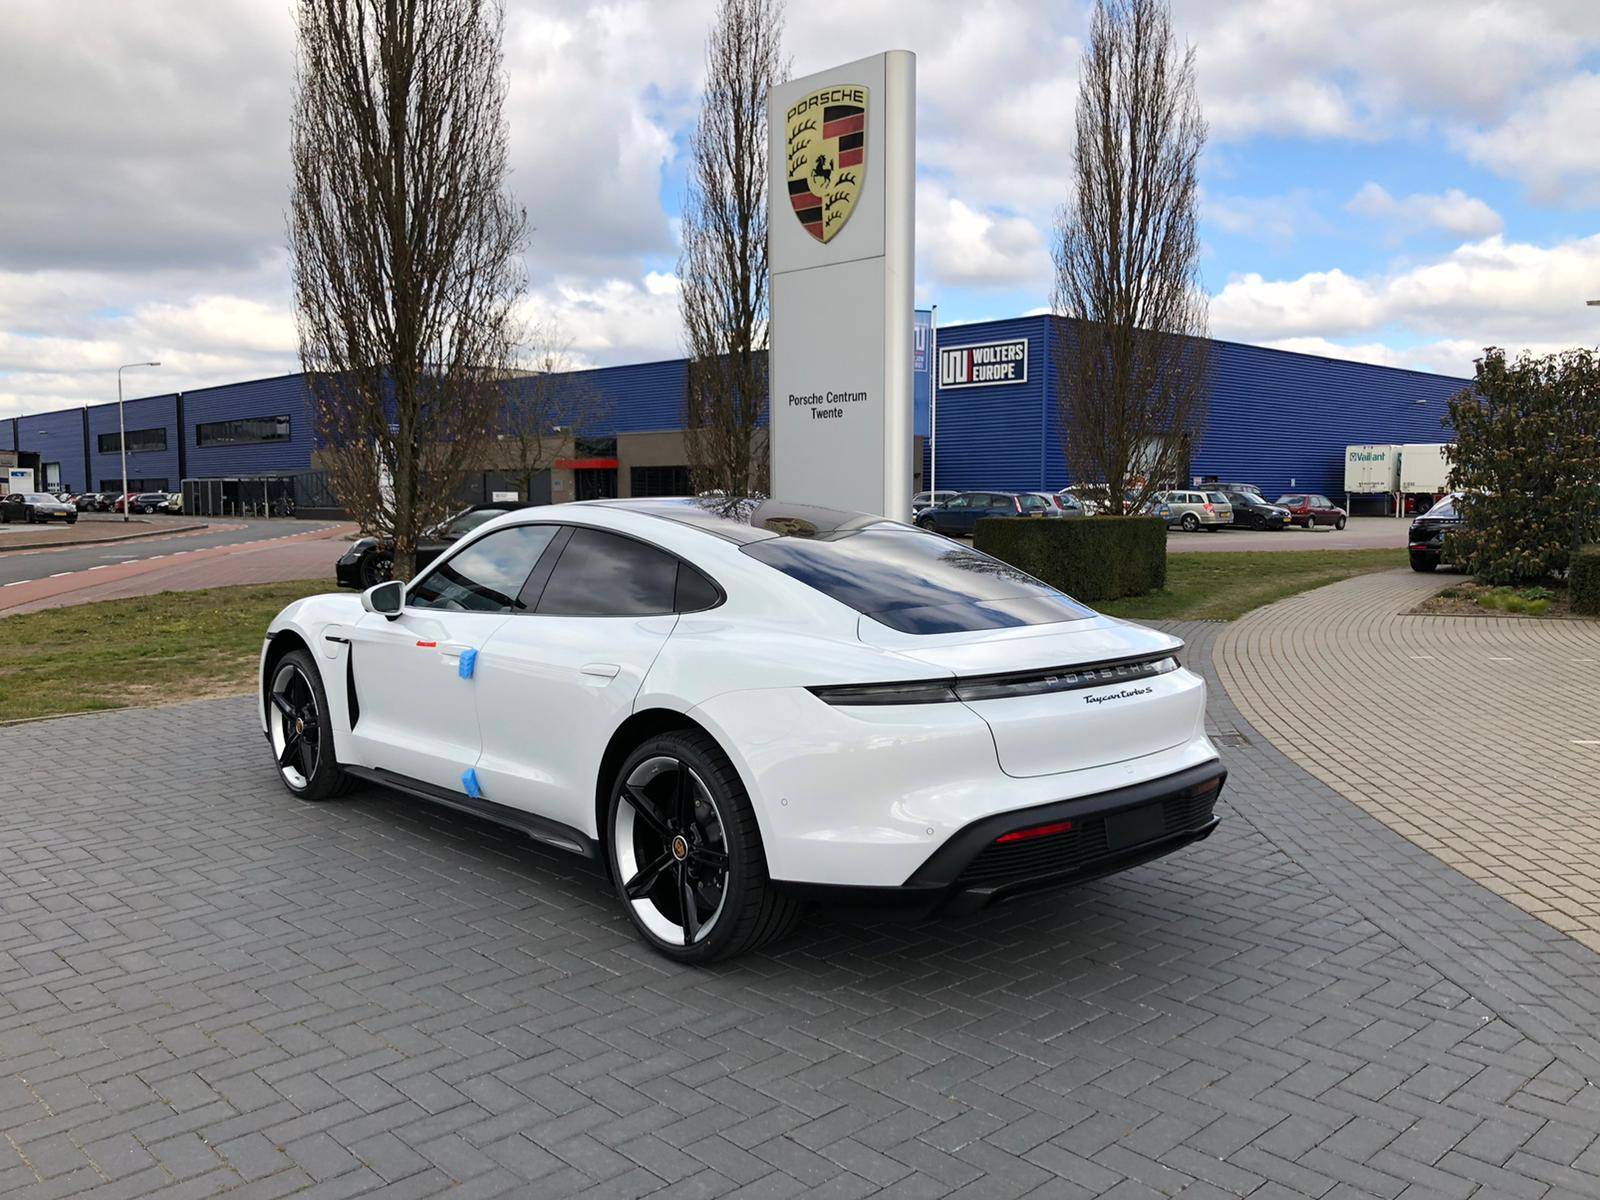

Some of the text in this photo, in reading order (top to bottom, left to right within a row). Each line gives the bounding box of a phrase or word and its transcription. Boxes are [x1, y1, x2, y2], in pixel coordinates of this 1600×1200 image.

[787, 89, 864, 123] PORSCHE
[972, 344, 1024, 364] WOLTERS
[972, 363, 1015, 382] EUROPE
[788, 391, 867, 406] Porsche Centrum
[811, 407, 843, 419] Twente
[1357, 451, 1385, 462] Vaillant
[1044, 661, 1152, 687] PORSCHE
